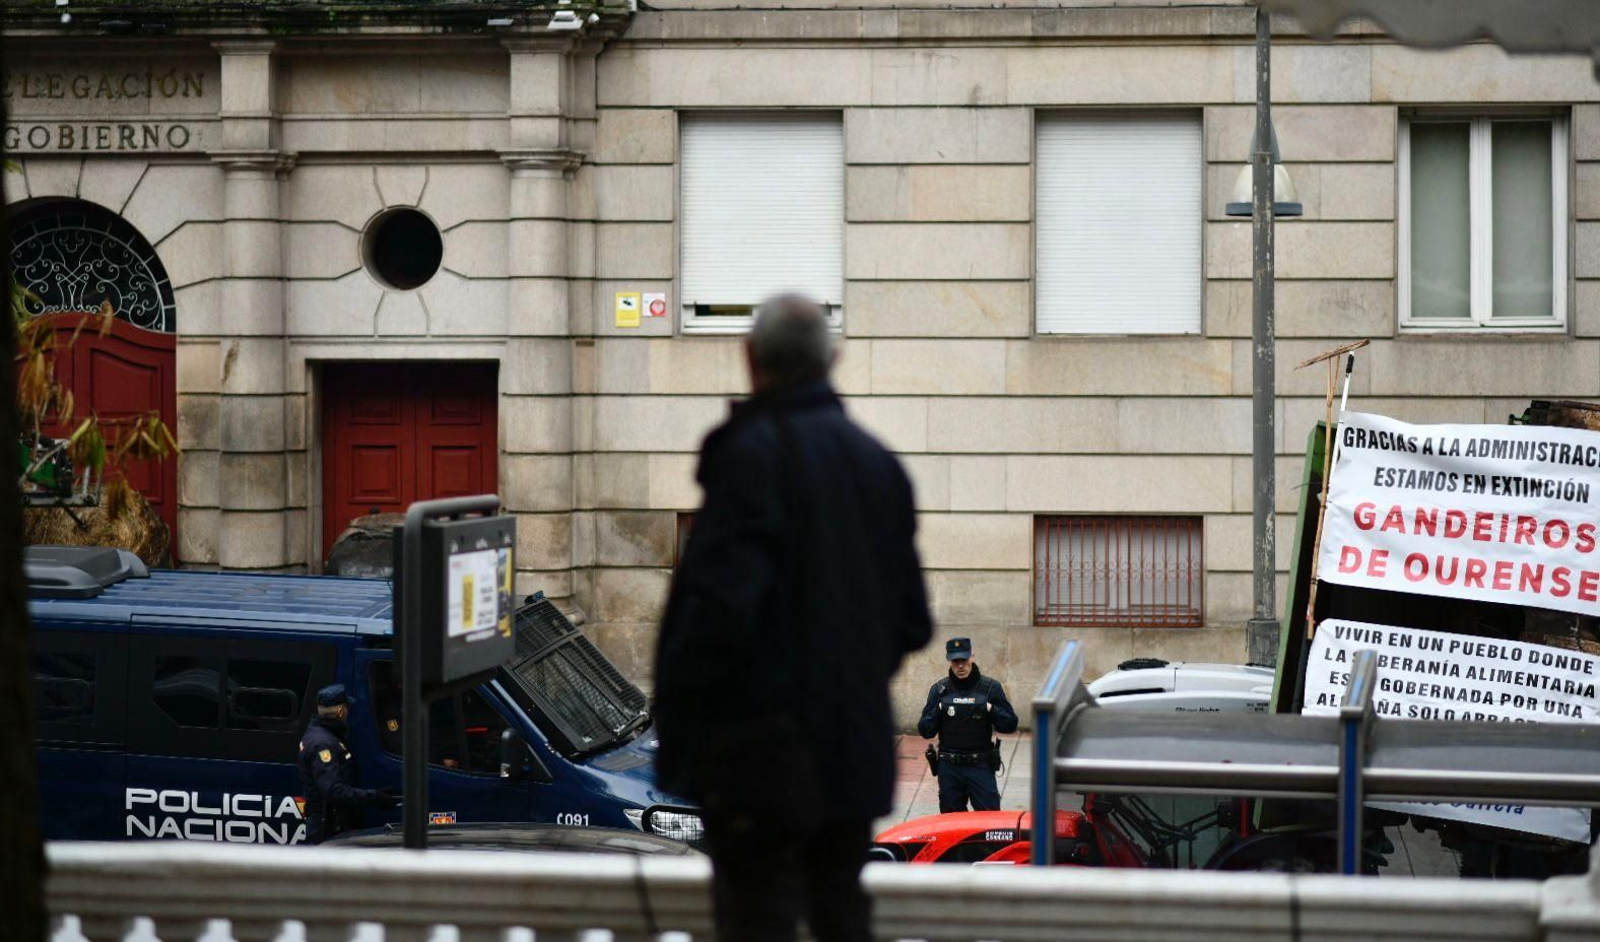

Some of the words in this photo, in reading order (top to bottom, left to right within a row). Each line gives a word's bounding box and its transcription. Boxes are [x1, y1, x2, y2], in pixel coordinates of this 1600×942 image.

[3, 125, 190, 149] GOBIERNO
[1343, 427, 1417, 454] GRACIAS
[1422, 437, 1433, 456] A
[1438, 437, 1461, 457] LA
[1373, 466, 1457, 493] ESTAMOS
[1463, 474, 1486, 494] EN
[1491, 475, 1590, 503] EXTINCIÓN
[1353, 502, 1597, 553] GANDEIROS
[1338, 545, 1389, 578] DE
[1403, 552, 1600, 602] OURENSE
[1334, 625, 1383, 645] VIVIR
[1388, 632, 1412, 648] EN
[1417, 635, 1444, 652] UN
[1450, 639, 1522, 662] PUEBLO
[1528, 650, 1594, 675] DONDE
[1324, 647, 1346, 664] LA
[1352, 651, 1460, 678] BERANÍA
[1465, 665, 1596, 699] ALIMENTARIA
[1380, 677, 1494, 706] GOBERNADA
[1500, 692, 1537, 711] POR
[1543, 699, 1583, 719] UNA
[126, 815, 307, 845] NACIONA
